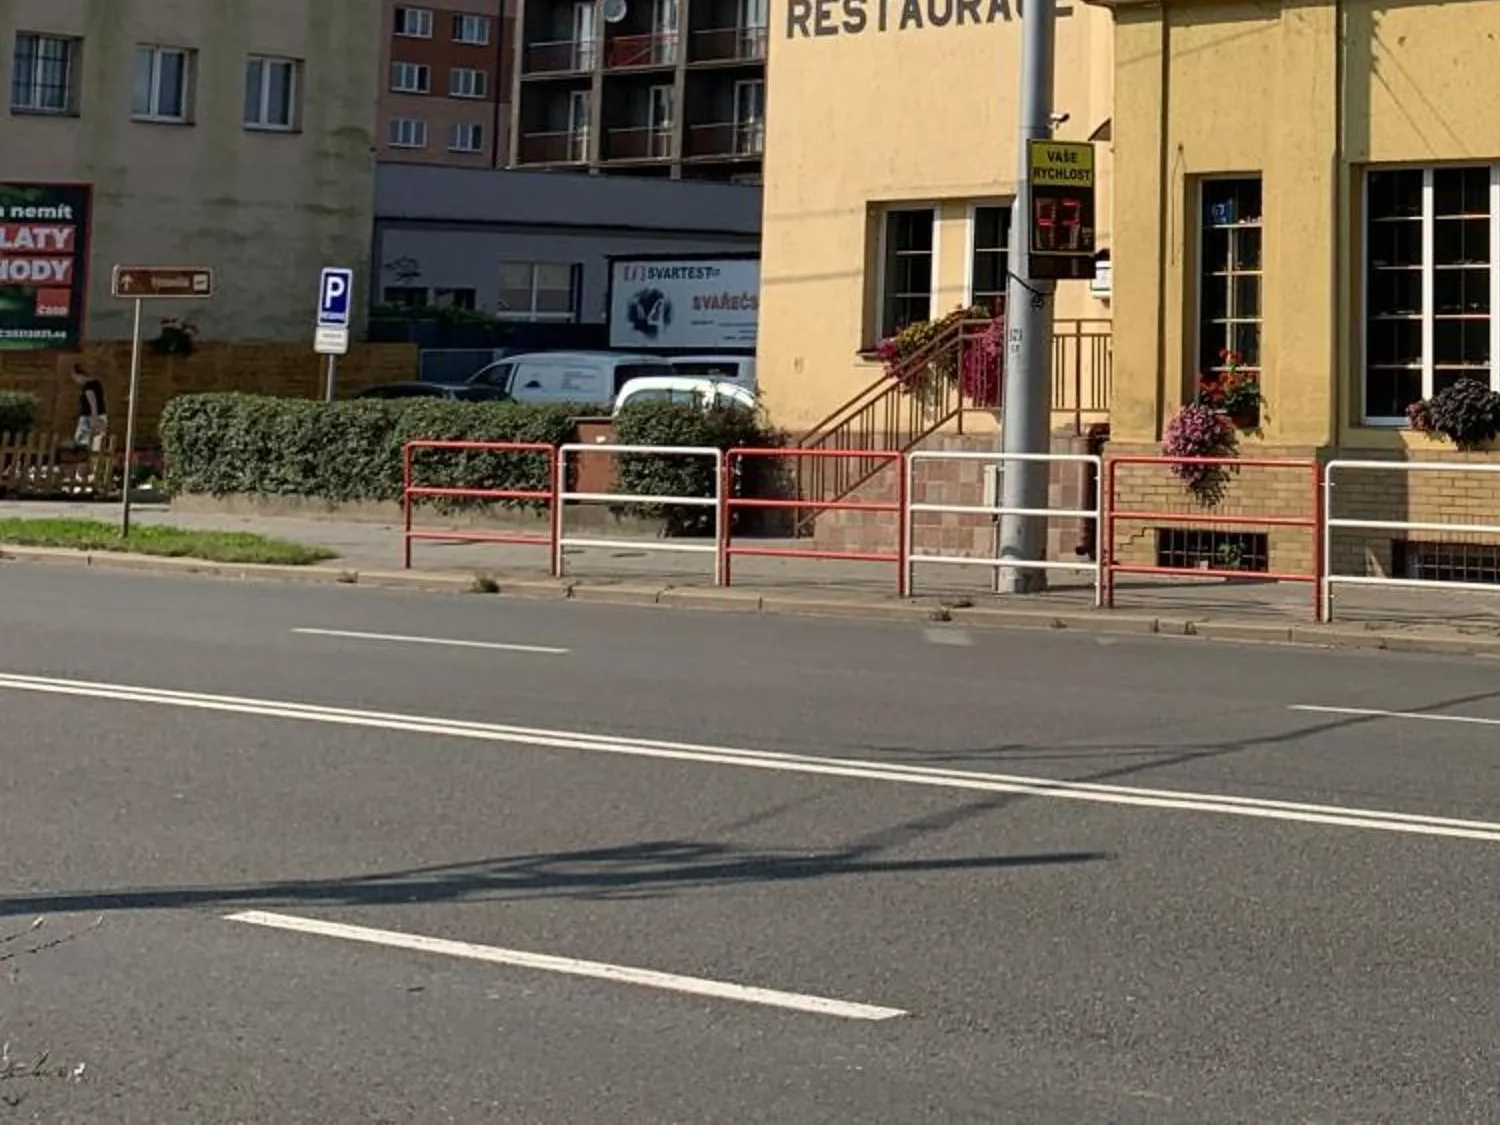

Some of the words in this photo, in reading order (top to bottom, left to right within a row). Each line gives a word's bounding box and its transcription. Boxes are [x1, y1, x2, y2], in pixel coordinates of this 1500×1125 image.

[1047, 148, 1079, 164] VAŠE
[1034, 166, 1090, 180] RYCHLOST
[10, 203, 73, 220] nemít
[325, 276, 345, 309] P
